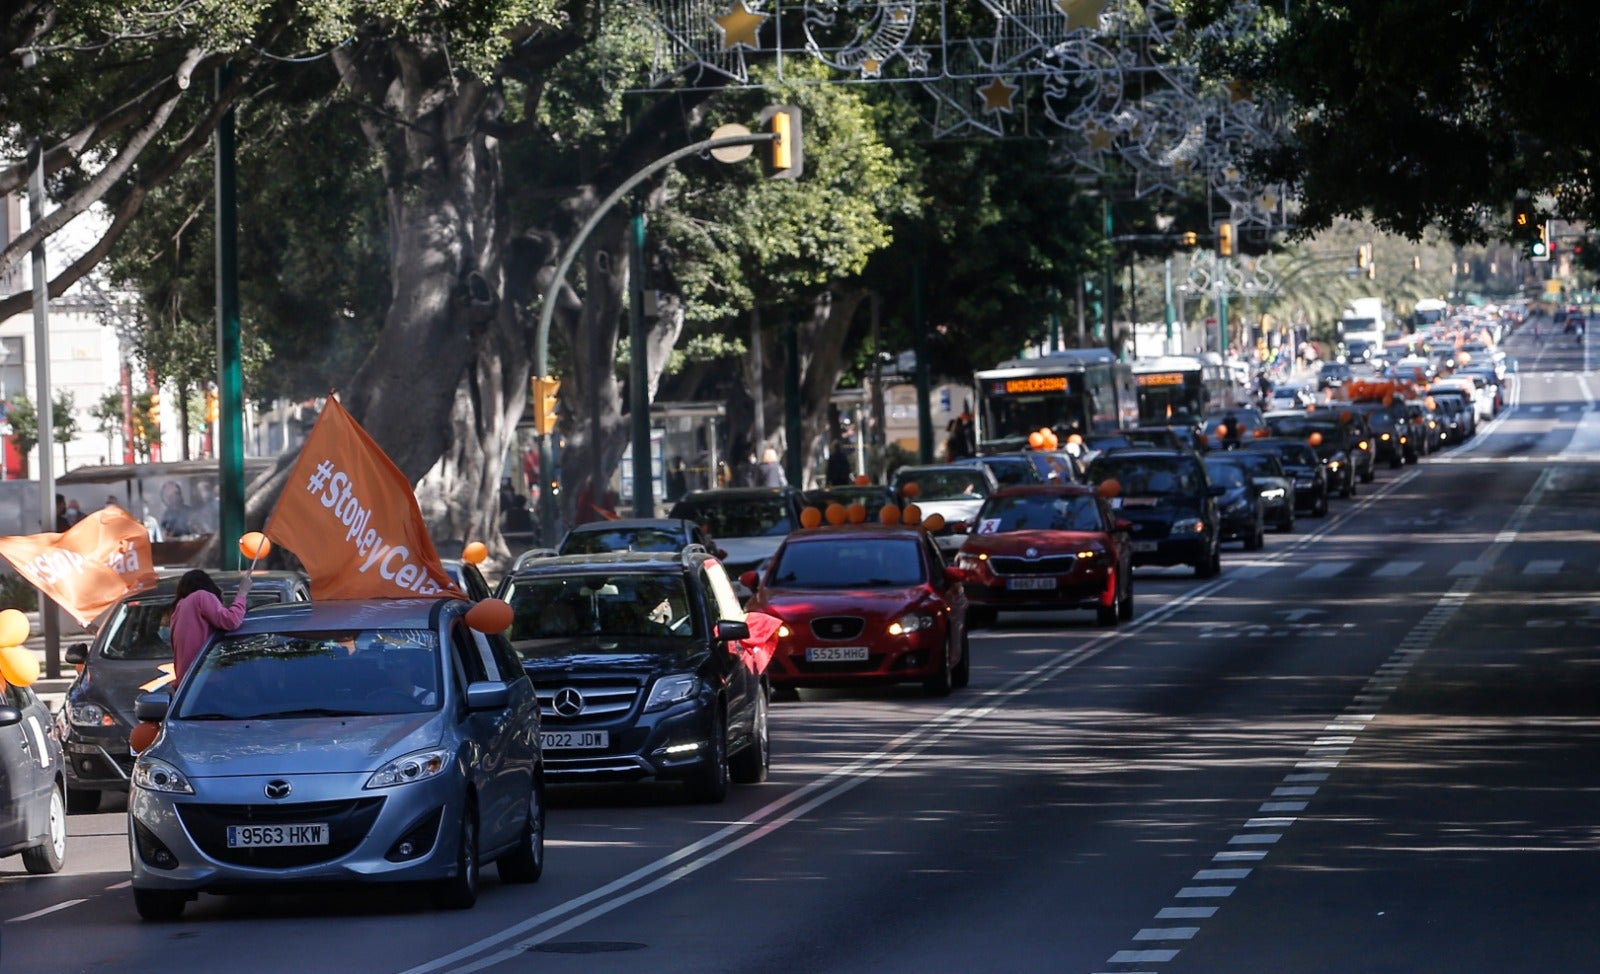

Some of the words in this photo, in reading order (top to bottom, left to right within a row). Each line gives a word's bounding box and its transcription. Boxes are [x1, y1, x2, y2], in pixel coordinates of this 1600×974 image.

[306, 459, 455, 595] #StopLeyCela
[241, 827, 284, 845] 9563
[289, 825, 321, 844] HKW
